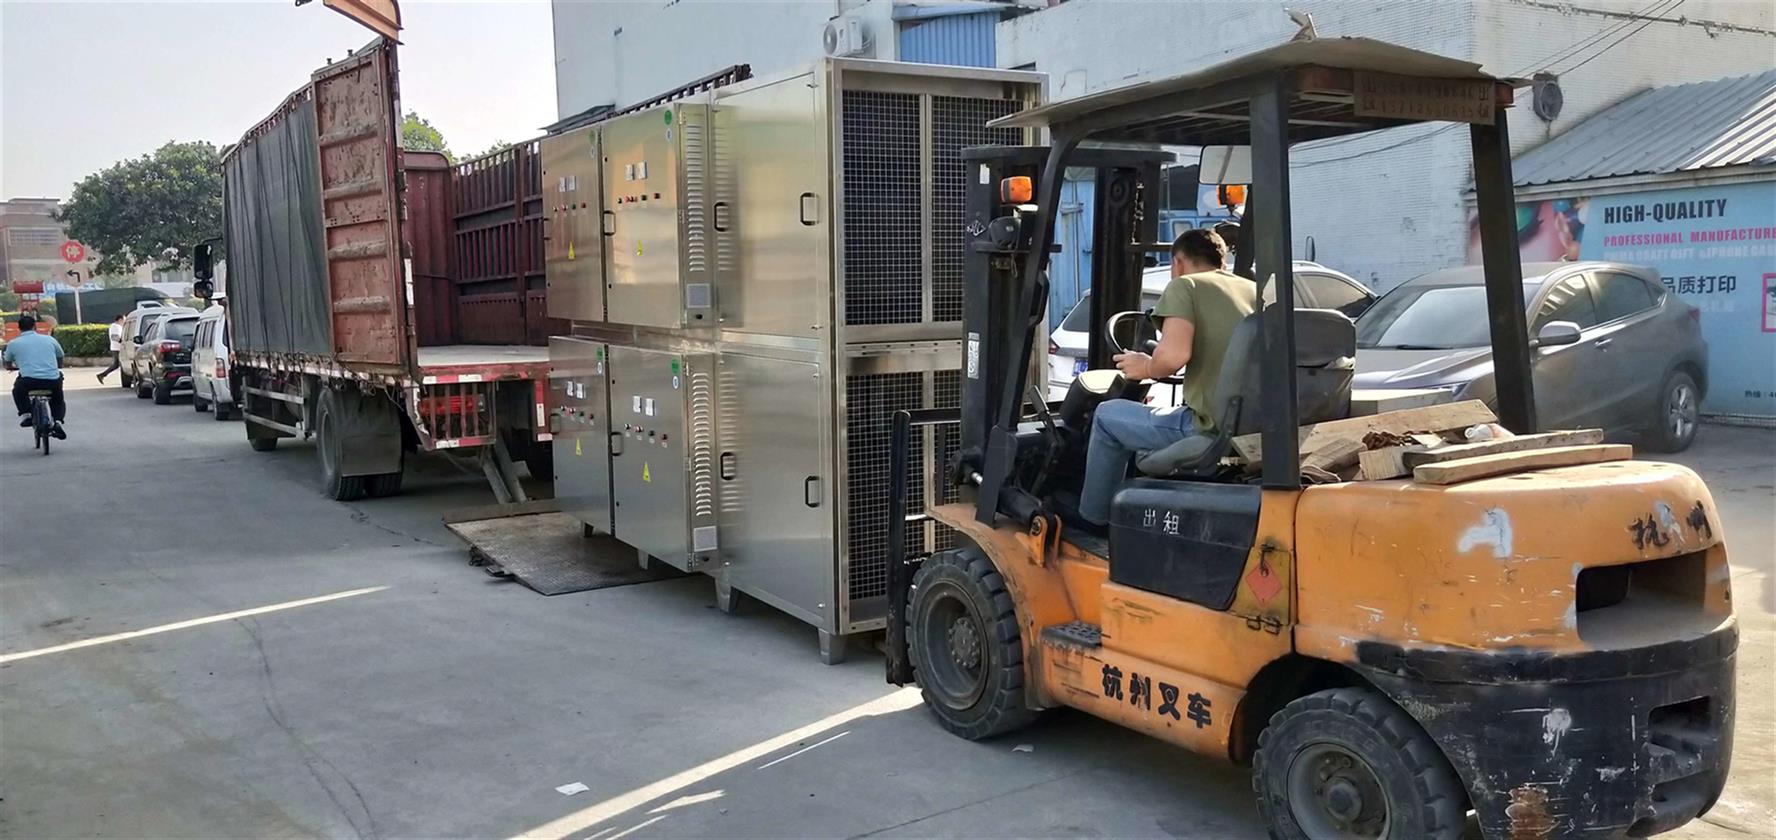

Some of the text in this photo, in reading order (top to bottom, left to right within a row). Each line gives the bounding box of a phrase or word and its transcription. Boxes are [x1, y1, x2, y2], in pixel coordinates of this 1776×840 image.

[1604, 199, 1727, 224] HIGH-QUALITY
[1603, 232, 1683, 247] PROFESSIONAL
[1143, 508, 1180, 535] 出租
[1102, 664, 1212, 728] 杭州叉车
